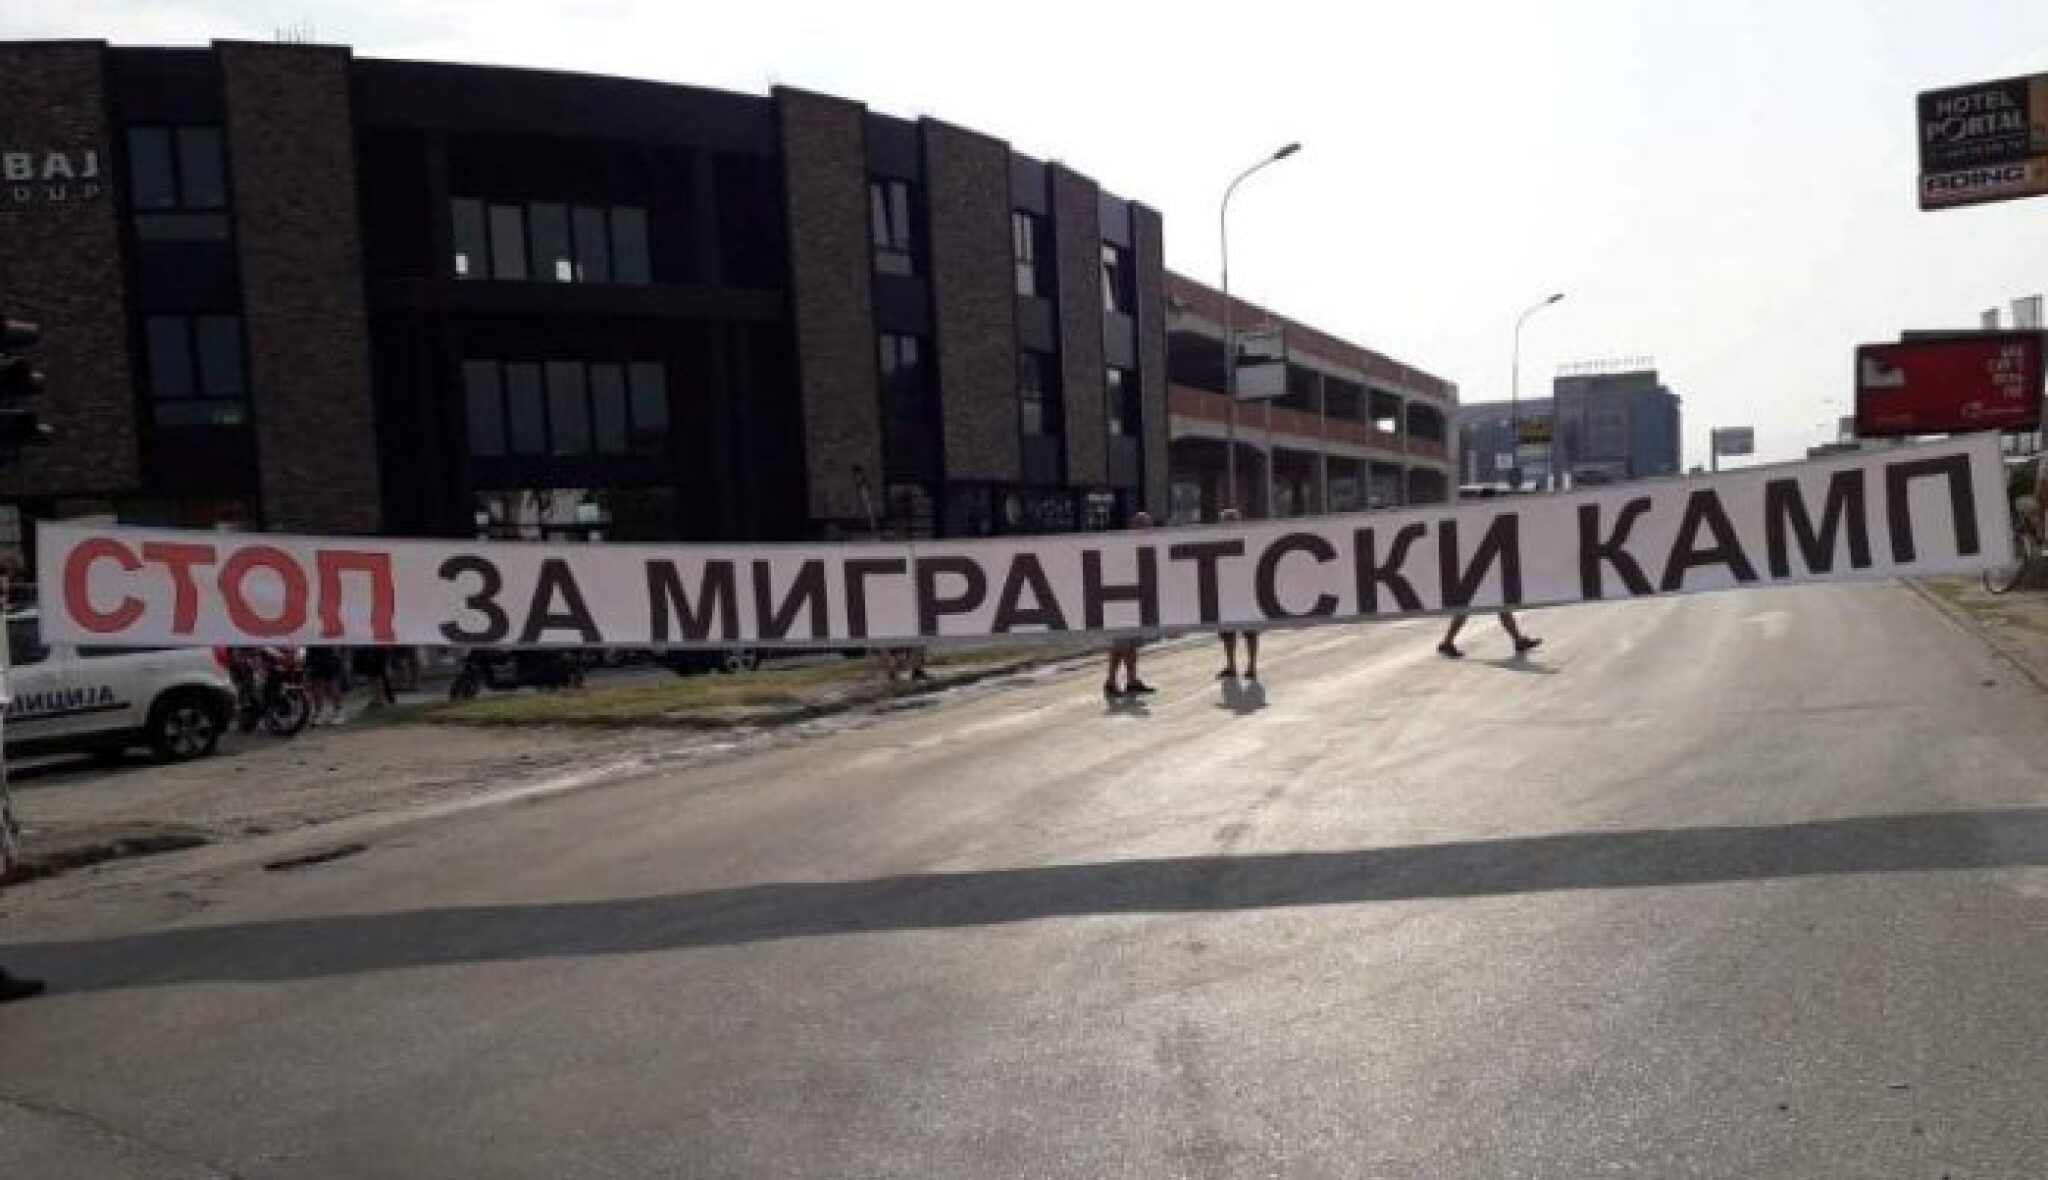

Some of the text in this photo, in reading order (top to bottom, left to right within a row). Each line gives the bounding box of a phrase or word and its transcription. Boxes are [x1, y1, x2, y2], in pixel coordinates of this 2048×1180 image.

[1935, 89, 2015, 118] HOTEL
[1926, 108, 2024, 142] PORTAL
[3, 150, 99, 180] BAJ
[64, 453, 1981, 643] СТОП ЗА МИГРАНТСКИ КАМП
